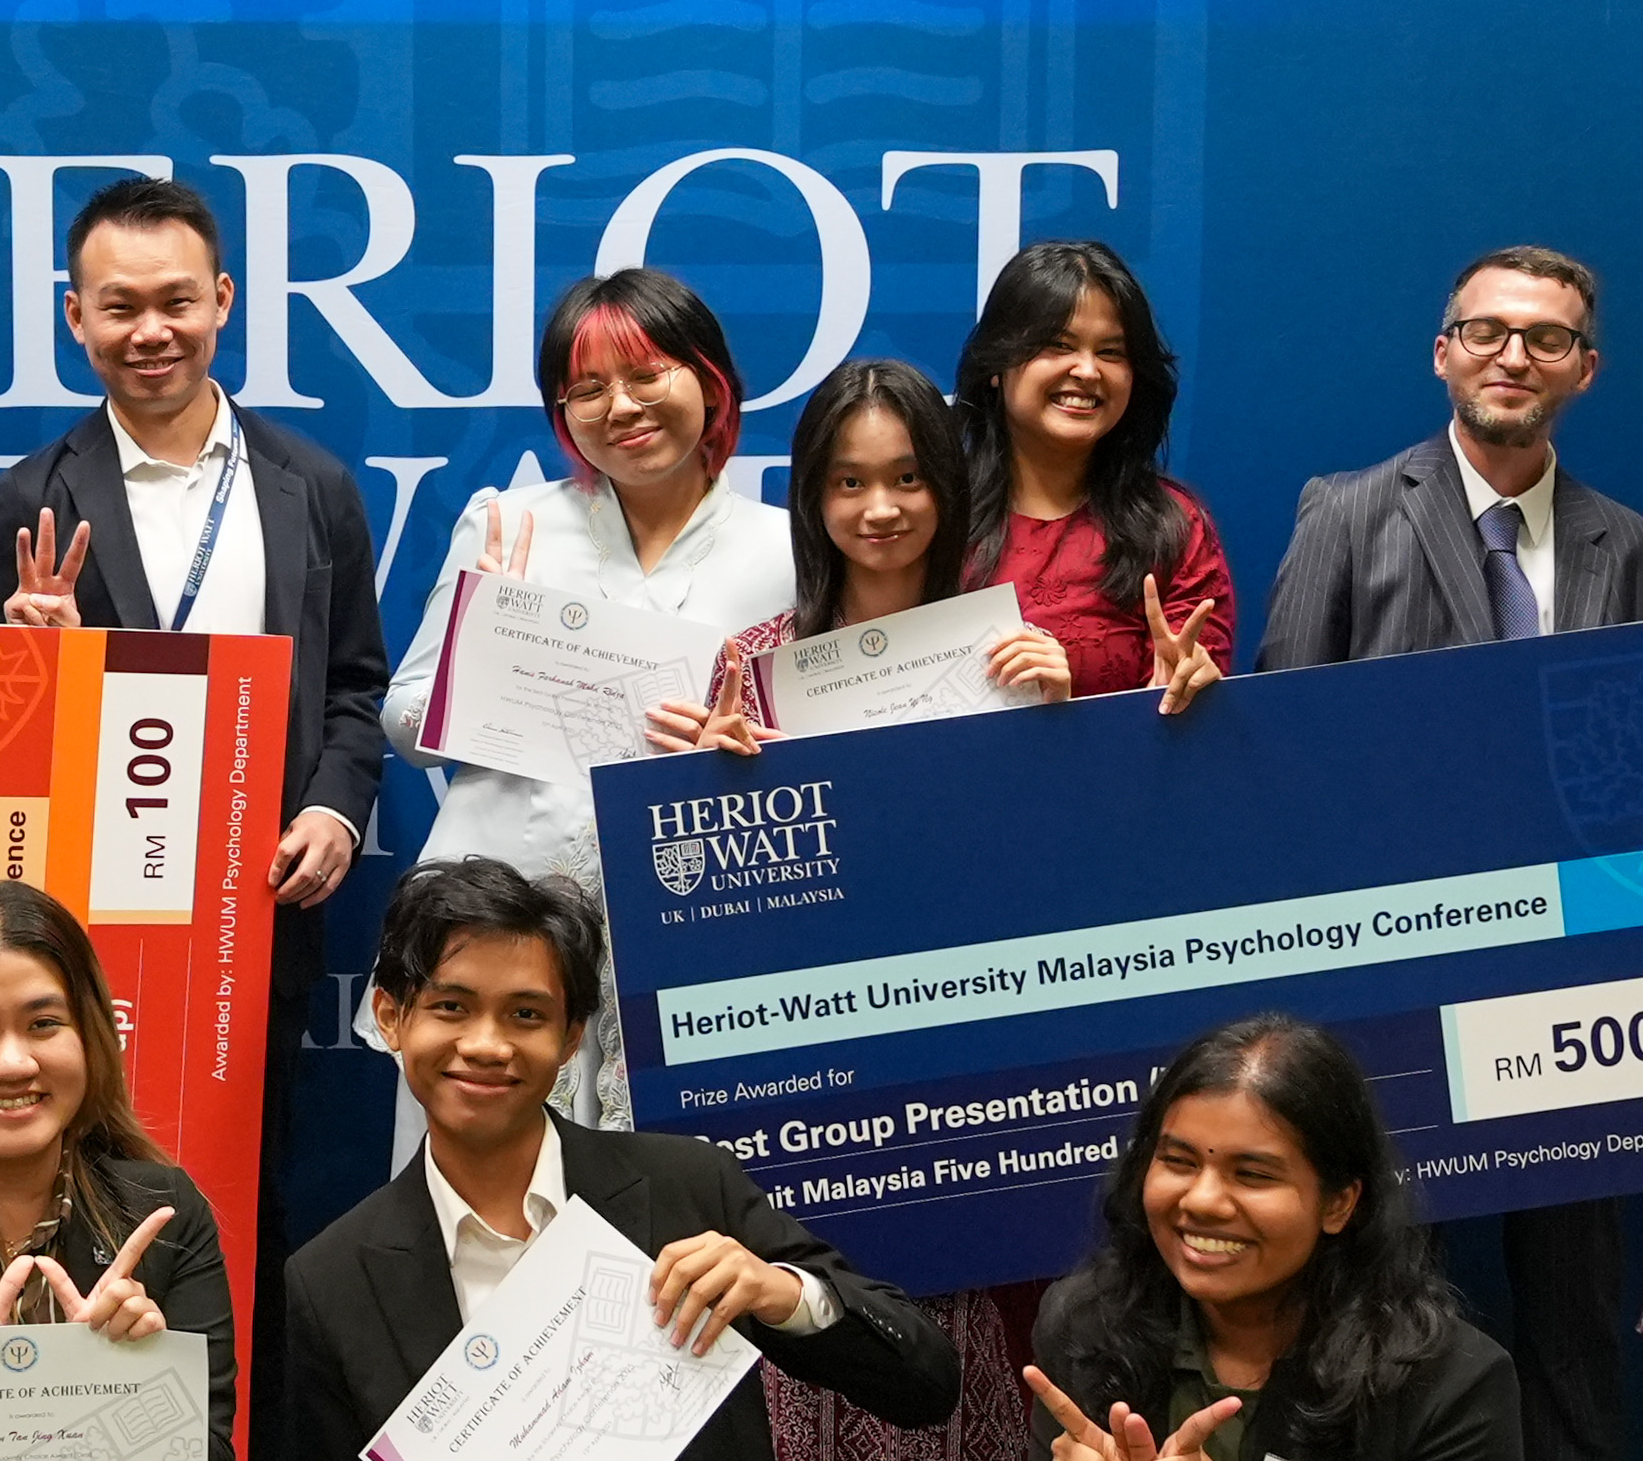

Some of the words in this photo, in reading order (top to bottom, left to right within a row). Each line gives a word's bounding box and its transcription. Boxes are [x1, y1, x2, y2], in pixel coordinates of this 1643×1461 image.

[216, 470, 235, 504] Shaping
[494, 625, 564, 650] CERTIFICATE
[565, 642, 582, 652] OF
[582, 646, 660, 671] ACHIEVEMENT
[806, 672, 877, 699] CERTIFICATE
[879, 665, 894, 677] OF
[896, 645, 974, 673] ACHIEVEMENT
[228, 676, 255, 785] Department
[126, 717, 174, 821] 100
[647, 780, 833, 841] HERIOT
[143, 835, 166, 880] RM
[221, 789, 249, 891] Psychology
[706, 820, 838, 871] WATT
[711, 858, 841, 892] UNIVERSITY
[218, 896, 238, 964] HWUM
[660, 909, 686, 926] UK
[700, 899, 751, 920] DUBAI
[766, 887, 845, 910] MALAYSIA
[215, 969, 234, 995] by:
[671, 989, 859, 1040] Heriot-Watt
[867, 965, 1028, 1012] University
[1036, 943, 1176, 986] Malaysia
[1186, 915, 1363, 966] Psychology
[1371, 893, 1549, 939] Conference
[211, 996, 232, 1082] Awarded
[680, 1086, 729, 1110] Prize
[734, 1072, 823, 1103] Awarded
[826, 1066, 856, 1088] for
[1494, 1052, 1544, 1083] RM
[778, 1114, 896, 1154] Group
[904, 1077, 1140, 1132] Presentation
[802, 1167, 926, 1208] Malaysia
[933, 1157, 992, 1184] Five
[998, 1135, 1119, 1177] Hundred
[1415, 1153, 1490, 1181] HWUM
[1494, 1139, 1602, 1171] Psychology
[17, 1386, 36, 1399] OF
[39, 1382, 142, 1399] ACHIEVEMENT
[448, 1382, 512, 1454] CERTIFICATE
[507, 1366, 524, 1384] OF
[523, 1284, 588, 1365] ACHIEVEMENT
[406, 1372, 451, 1426] HERIOT
[425, 1381, 460, 1423] WATT
